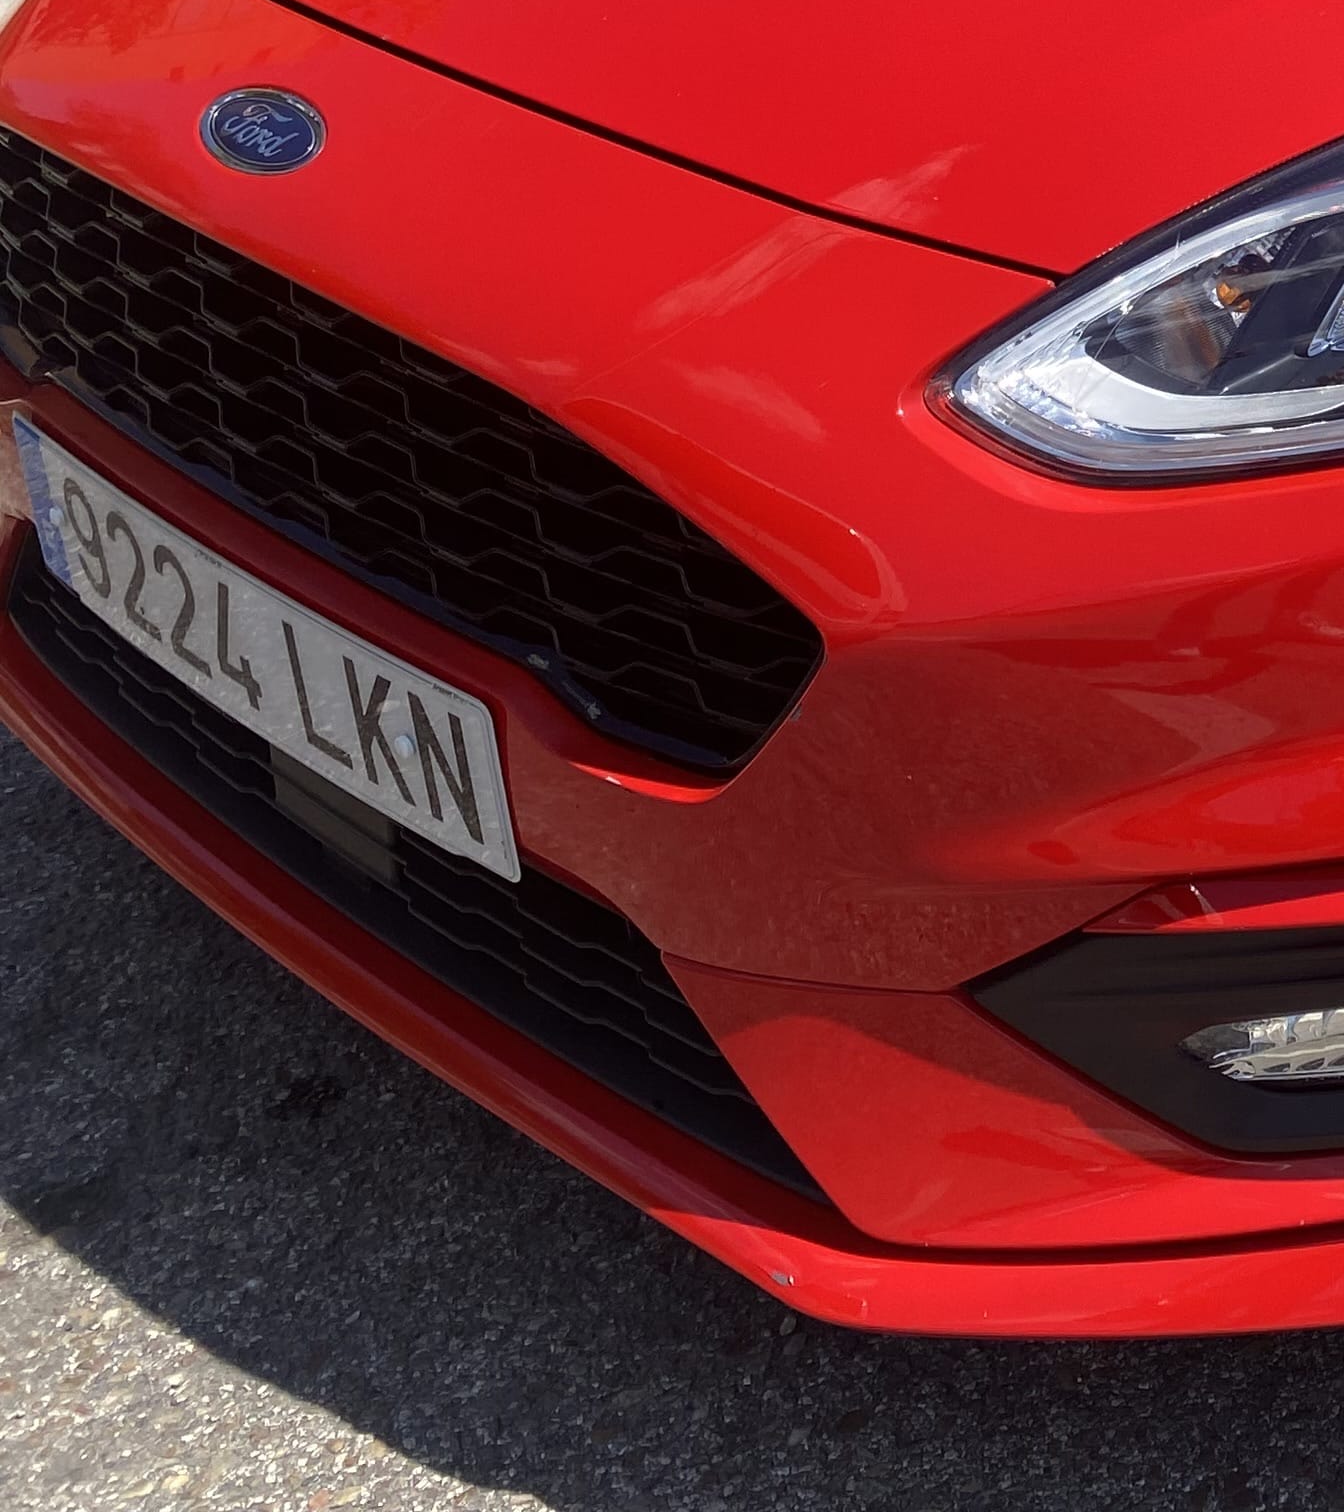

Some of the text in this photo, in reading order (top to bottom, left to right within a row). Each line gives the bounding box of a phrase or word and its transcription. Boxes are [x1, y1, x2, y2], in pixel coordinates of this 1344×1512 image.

[220, 103, 300, 157] Ford
[62, 476, 263, 712] 9224
[281, 619, 484, 845] LKN
